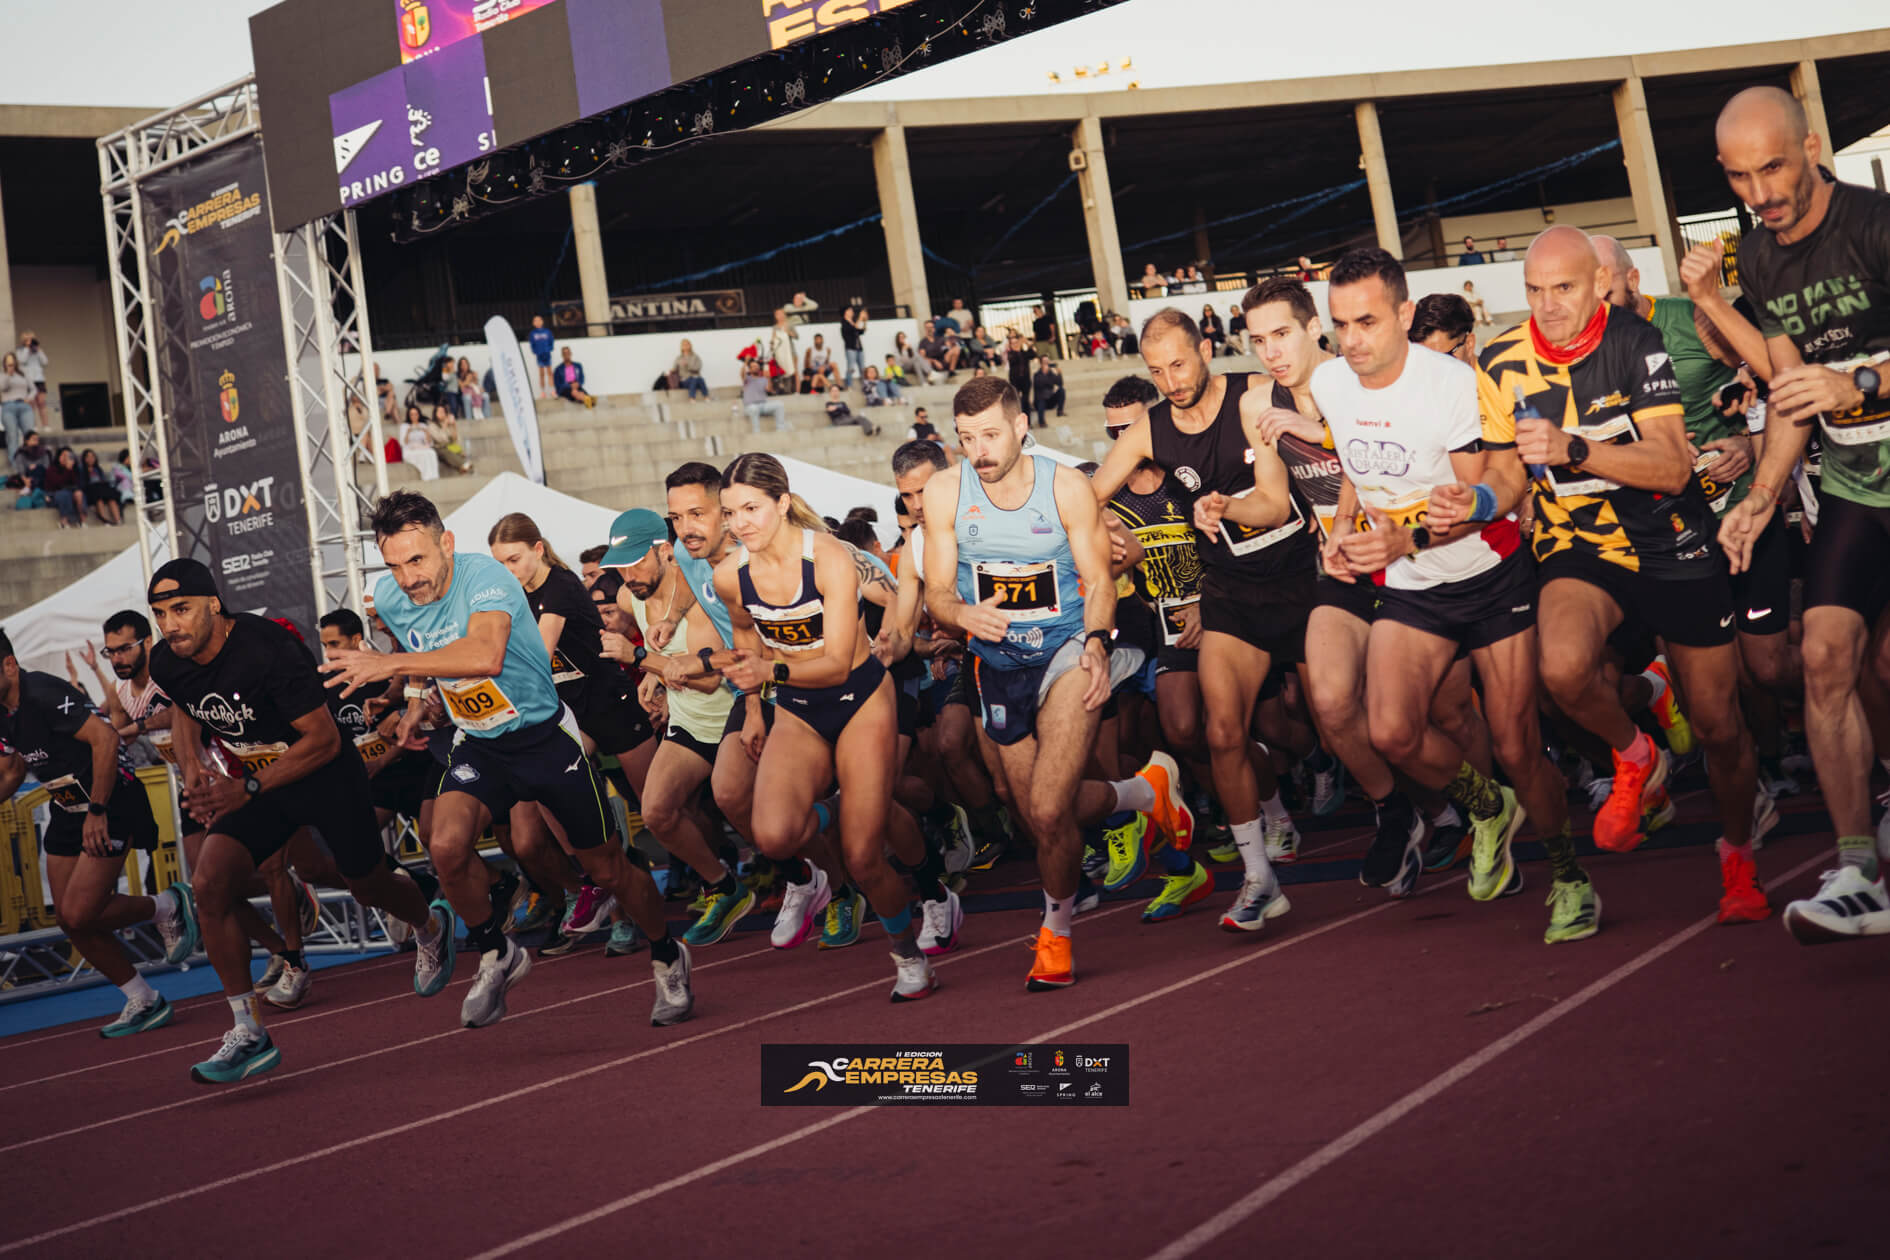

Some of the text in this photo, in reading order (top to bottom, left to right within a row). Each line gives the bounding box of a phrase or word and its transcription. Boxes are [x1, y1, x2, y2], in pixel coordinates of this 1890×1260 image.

[339, 166, 405, 205] PRING
[186, 192, 261, 234] EMPRESAS
[611, 298, 707, 318] ANTINA
[1766, 293, 1798, 317] NO
[218, 425, 249, 445] ARONA
[223, 476, 275, 519] DXT
[227, 511, 275, 537] TENERIFE
[222, 554, 251, 575] SER
[992, 582, 1038, 603] 871
[767, 624, 812, 642] 751
